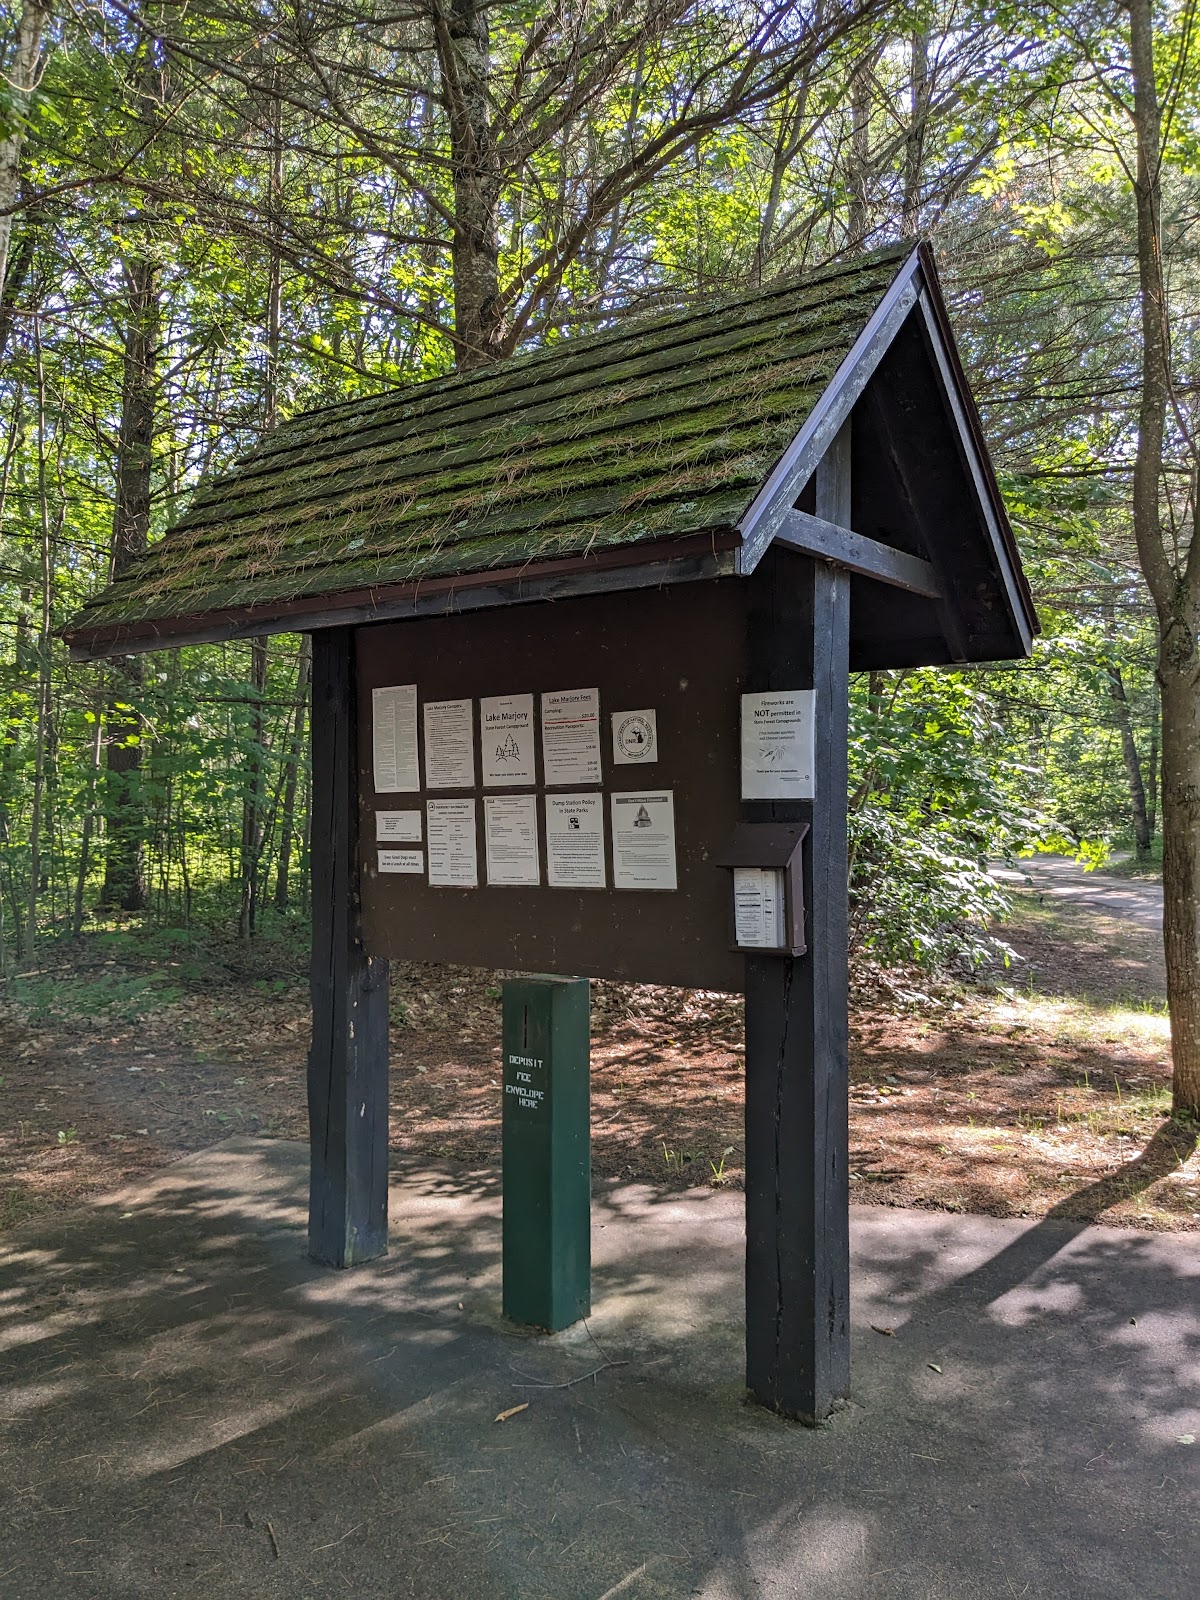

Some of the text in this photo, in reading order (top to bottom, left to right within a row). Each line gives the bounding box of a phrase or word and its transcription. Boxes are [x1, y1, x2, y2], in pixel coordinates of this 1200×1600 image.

[502, 711, 528, 721] Marjory
[509, 1055, 543, 1068] DEPOSIT
[517, 1072, 531, 1082] FEE
[506, 1085, 544, 1100] ENVELOPE
[519, 1097, 538, 1109] HERE
